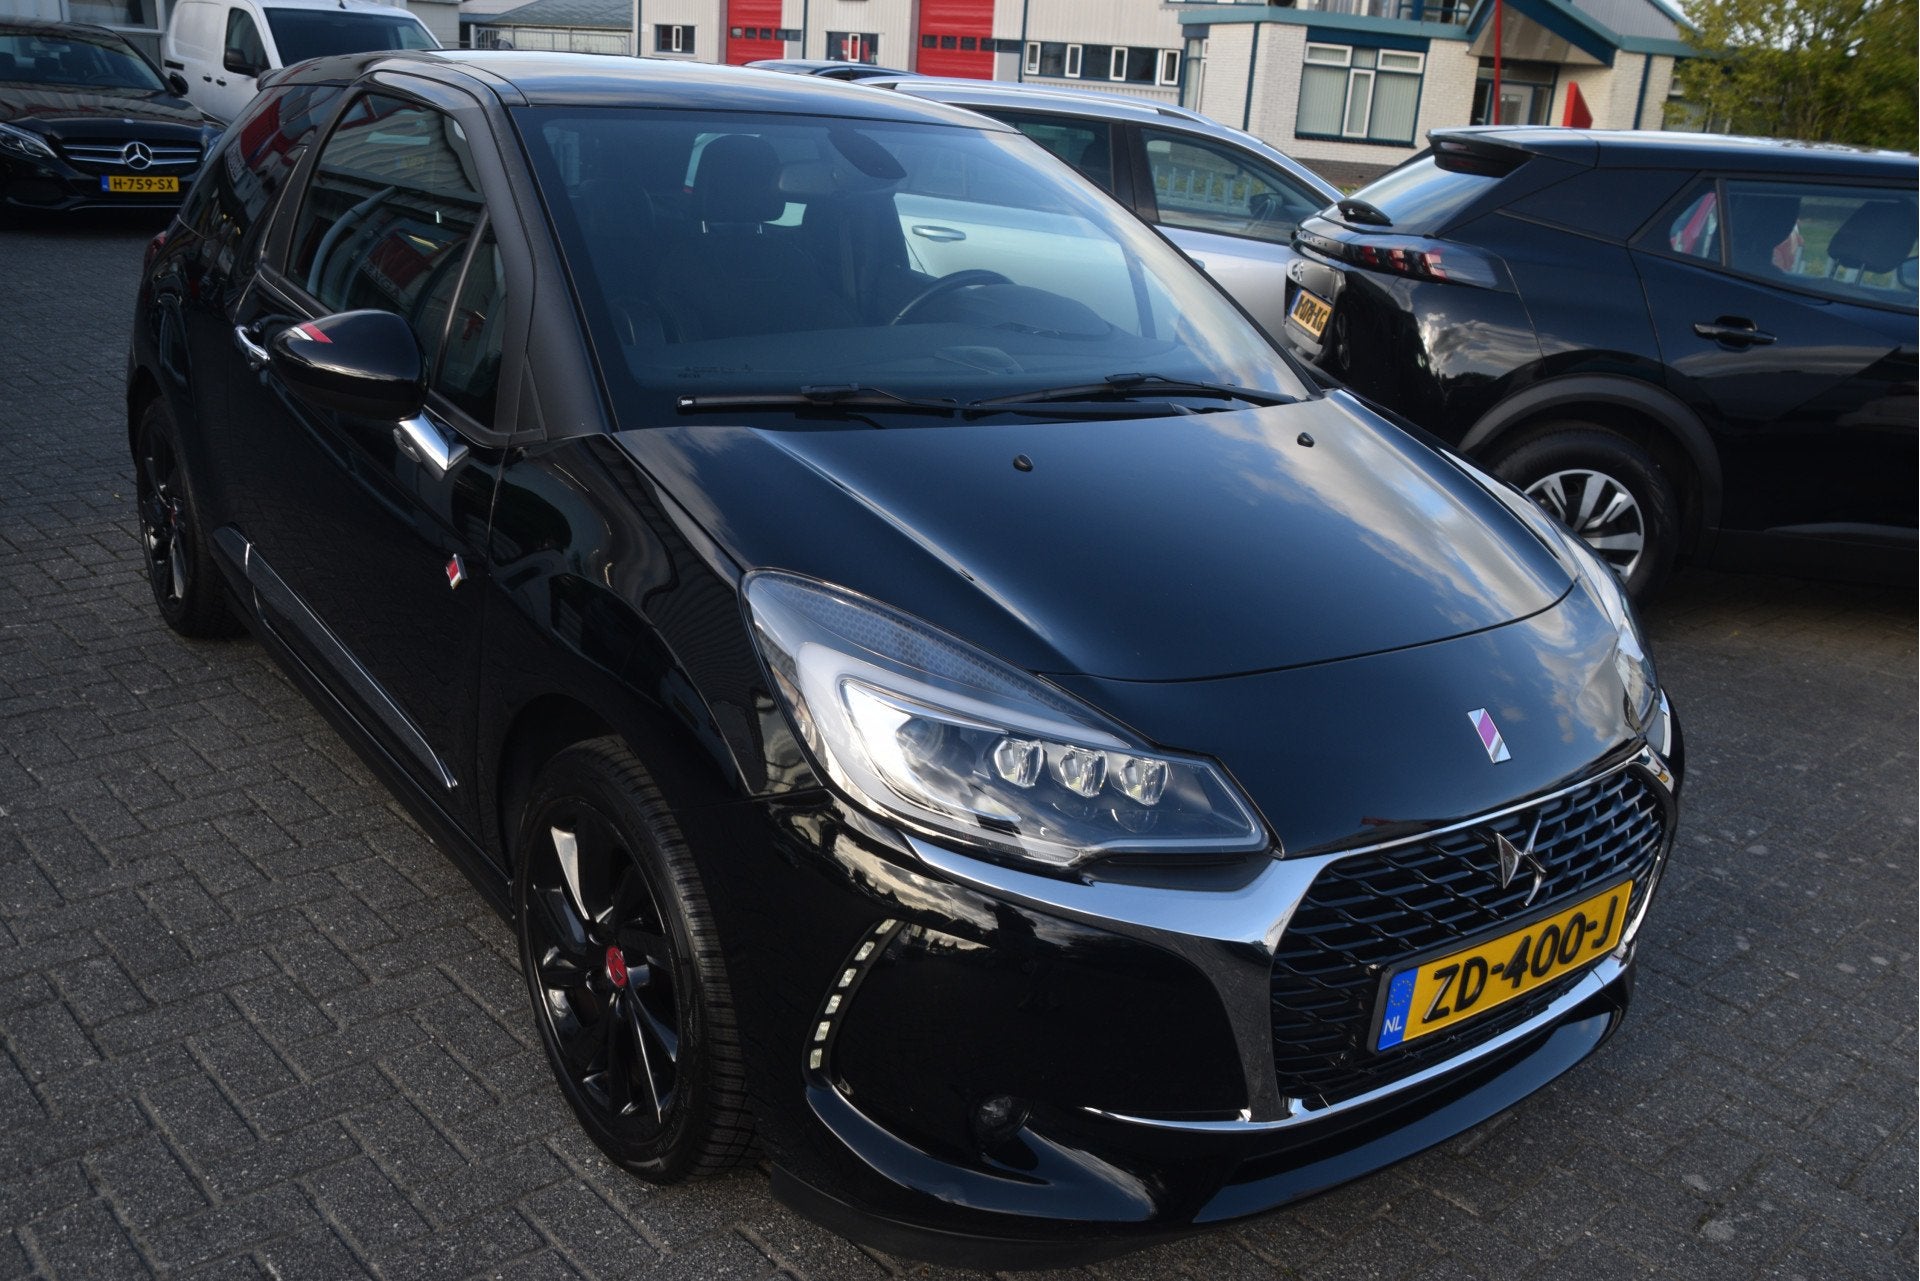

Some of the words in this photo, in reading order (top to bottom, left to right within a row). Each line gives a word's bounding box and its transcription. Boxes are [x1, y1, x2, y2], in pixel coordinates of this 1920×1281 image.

[113, 178, 174, 190] H-759-SX
[1421, 895, 1619, 1024] ZD-400-J
[1383, 1014, 1402, 1035] NL
